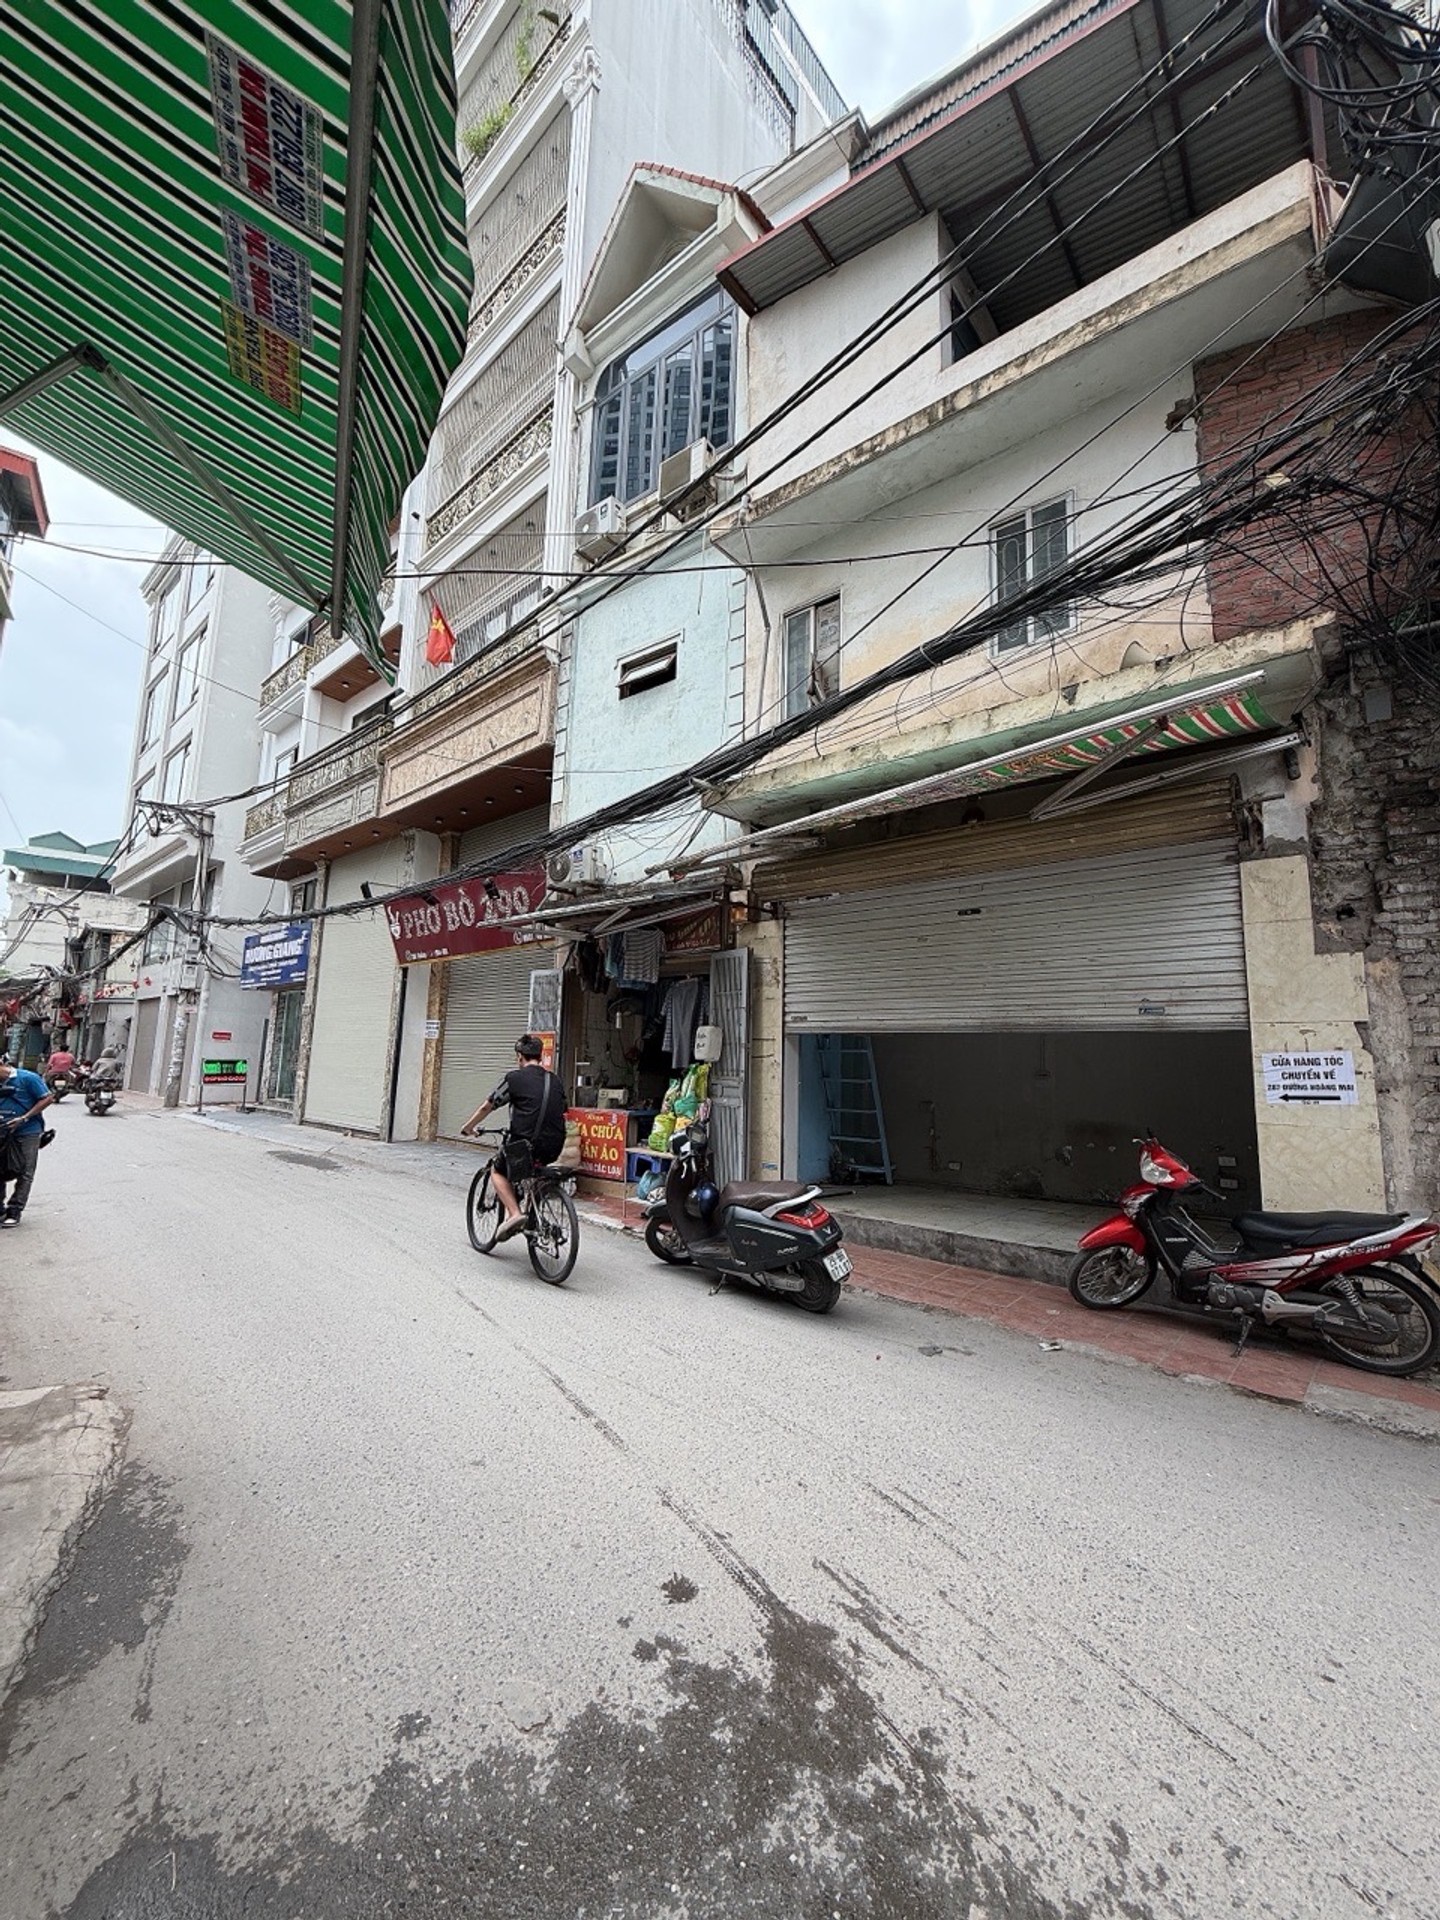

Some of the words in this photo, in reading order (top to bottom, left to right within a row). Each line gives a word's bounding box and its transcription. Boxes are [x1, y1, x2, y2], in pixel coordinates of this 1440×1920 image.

[238, 60, 266, 103] BN
[237, 94, 269, 163] THÀNH
[270, 86, 306, 222] 0987.650.222
[241, 155, 272, 201] PHÚ
[242, 223, 269, 263] TÍN
[249, 261, 273, 321] TRUNG
[241, 314, 260, 364] THÀNH
[444, 888, 475, 931] BÒ
[1272, 1055, 1291, 1066] CỬA
[1294, 1057, 1321, 1066] HÀNG
[1324, 1056, 1343, 1066] TÓC
[591, 1122, 623, 1141] CHỮA
[600, 1143, 618, 1160] ÁO
